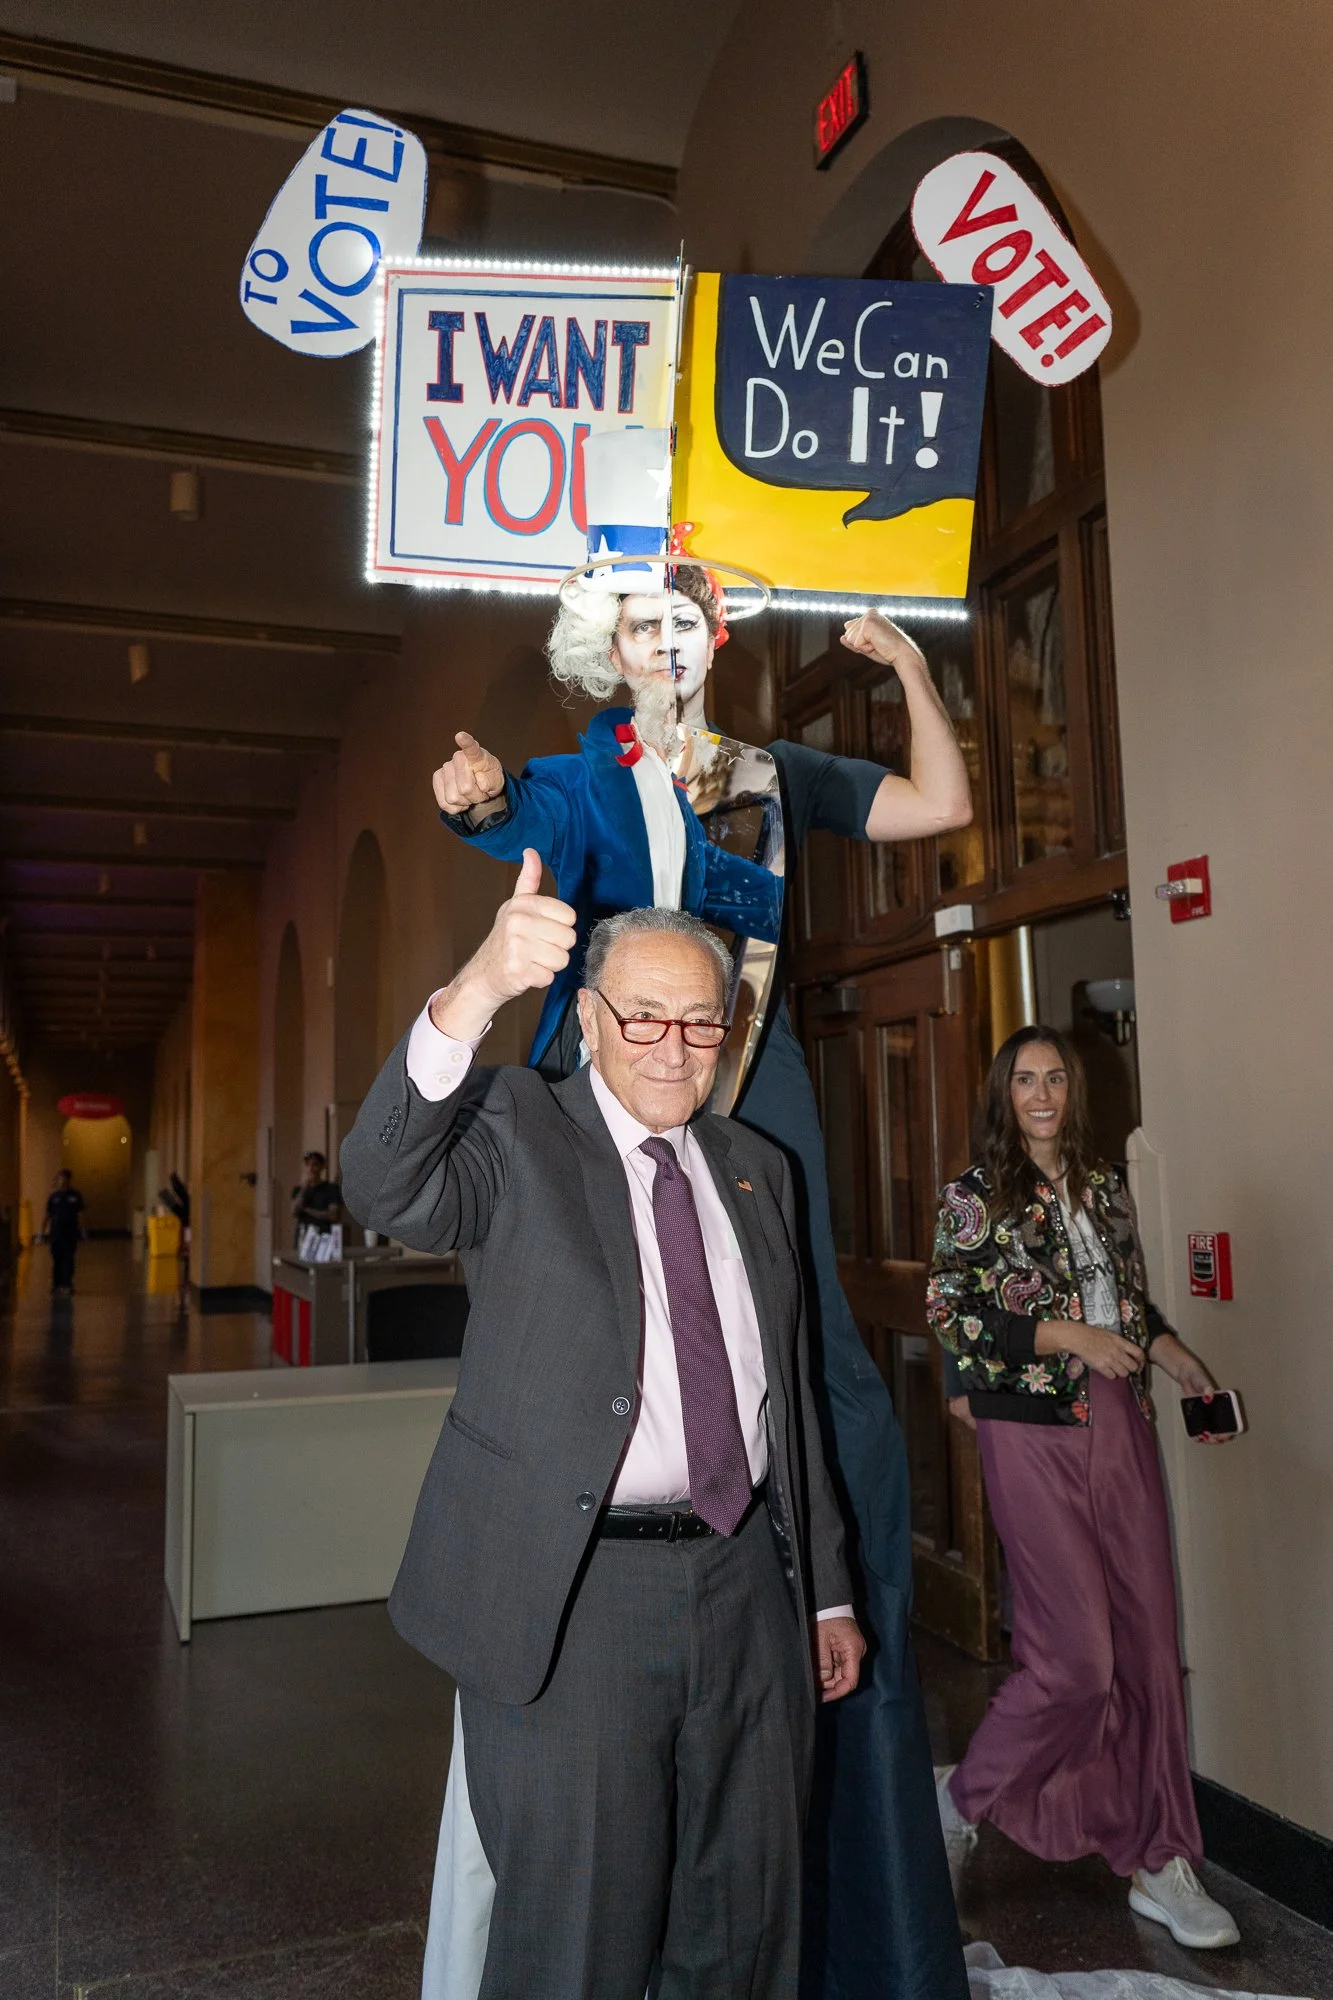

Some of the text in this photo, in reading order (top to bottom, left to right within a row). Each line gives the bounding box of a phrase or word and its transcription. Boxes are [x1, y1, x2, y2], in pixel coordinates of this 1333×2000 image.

[818, 64, 855, 152] EXIT
[290, 113, 405, 334] VOTE!
[938, 169, 1107, 368] VOTE!
[244, 248, 289, 305] TO
[426, 310, 650, 414] I WANT
[744, 377, 944, 469] Do It!
[1190, 1235, 1213, 1250] FIRE
